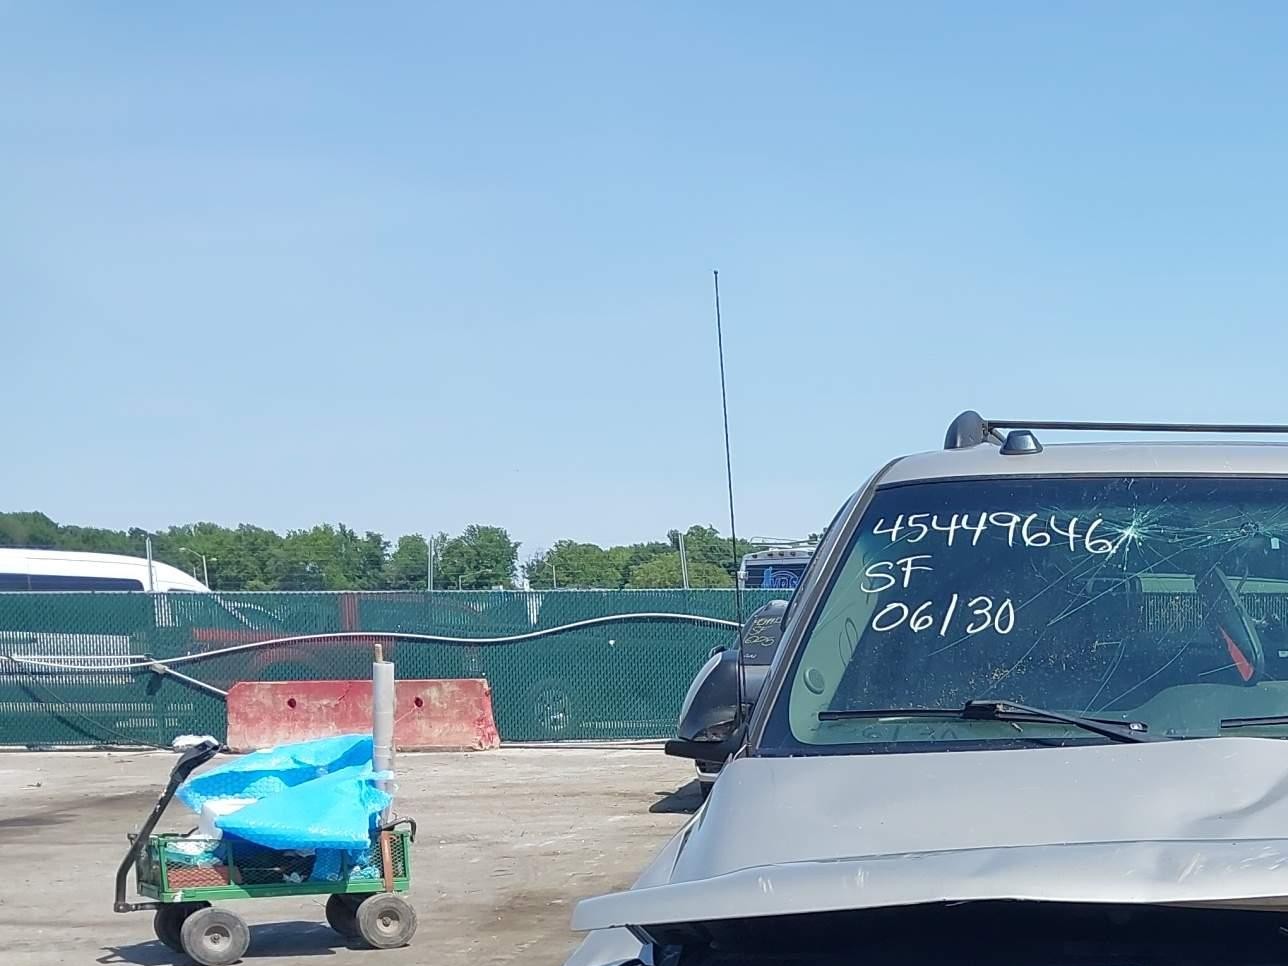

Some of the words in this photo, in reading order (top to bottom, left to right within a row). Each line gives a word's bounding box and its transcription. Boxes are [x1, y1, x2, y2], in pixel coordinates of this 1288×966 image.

[873, 512, 1113, 553] 45449646
[861, 555, 934, 592] SF
[872, 594, 1015, 636] 06/30
